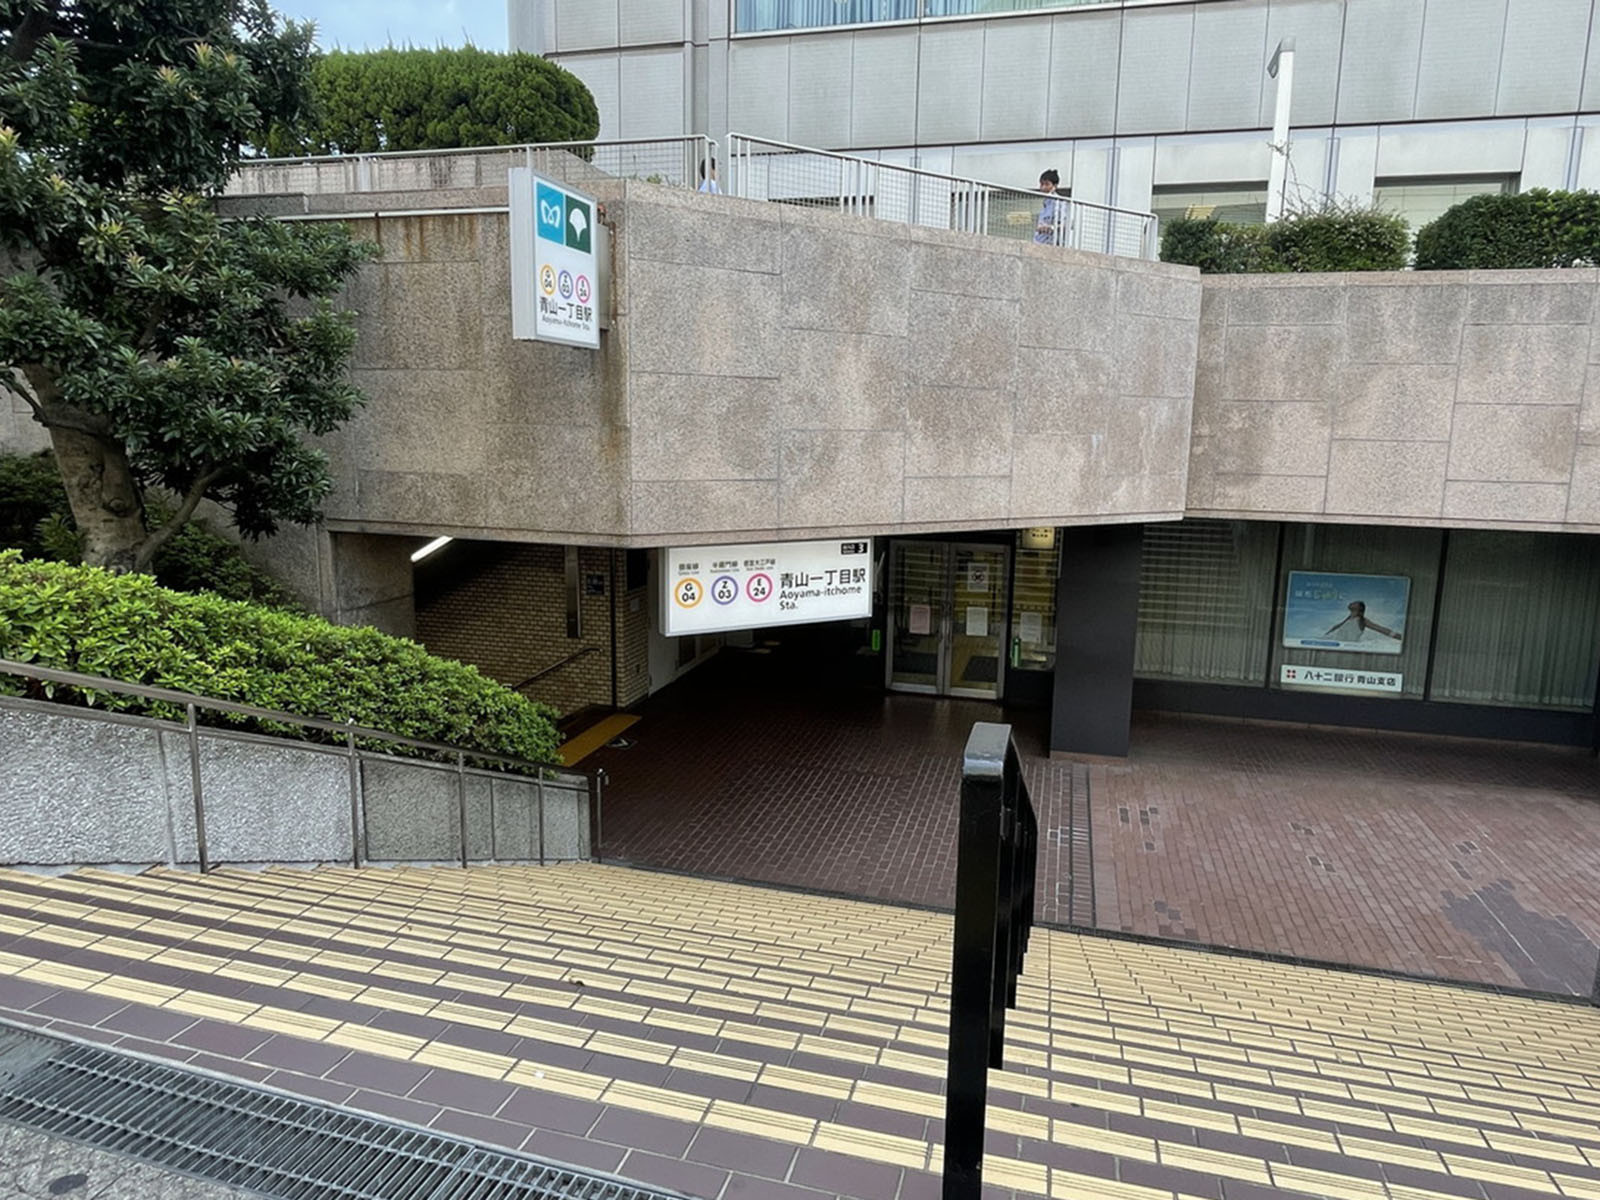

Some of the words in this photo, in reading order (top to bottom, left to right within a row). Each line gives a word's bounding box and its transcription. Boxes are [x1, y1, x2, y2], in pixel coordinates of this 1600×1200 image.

[539, 296, 592, 322] 青山一丁目駅
[858, 543, 864, 553] 3
[756, 578, 762, 587] E
[780, 568, 866, 588] 青山一丁目駅
[684, 582, 693, 592] G
[721, 580, 728, 589] Z
[681, 592, 696, 602] 04
[718, 589, 732, 600] 03
[752, 587, 766, 597] 24
[779, 585, 862, 601] Aoyama-itchome
[779, 601, 798, 610] Sta.
[1304, 670, 1355, 684] 八十二銀行
[1357, 675, 1396, 686] 青山支店
